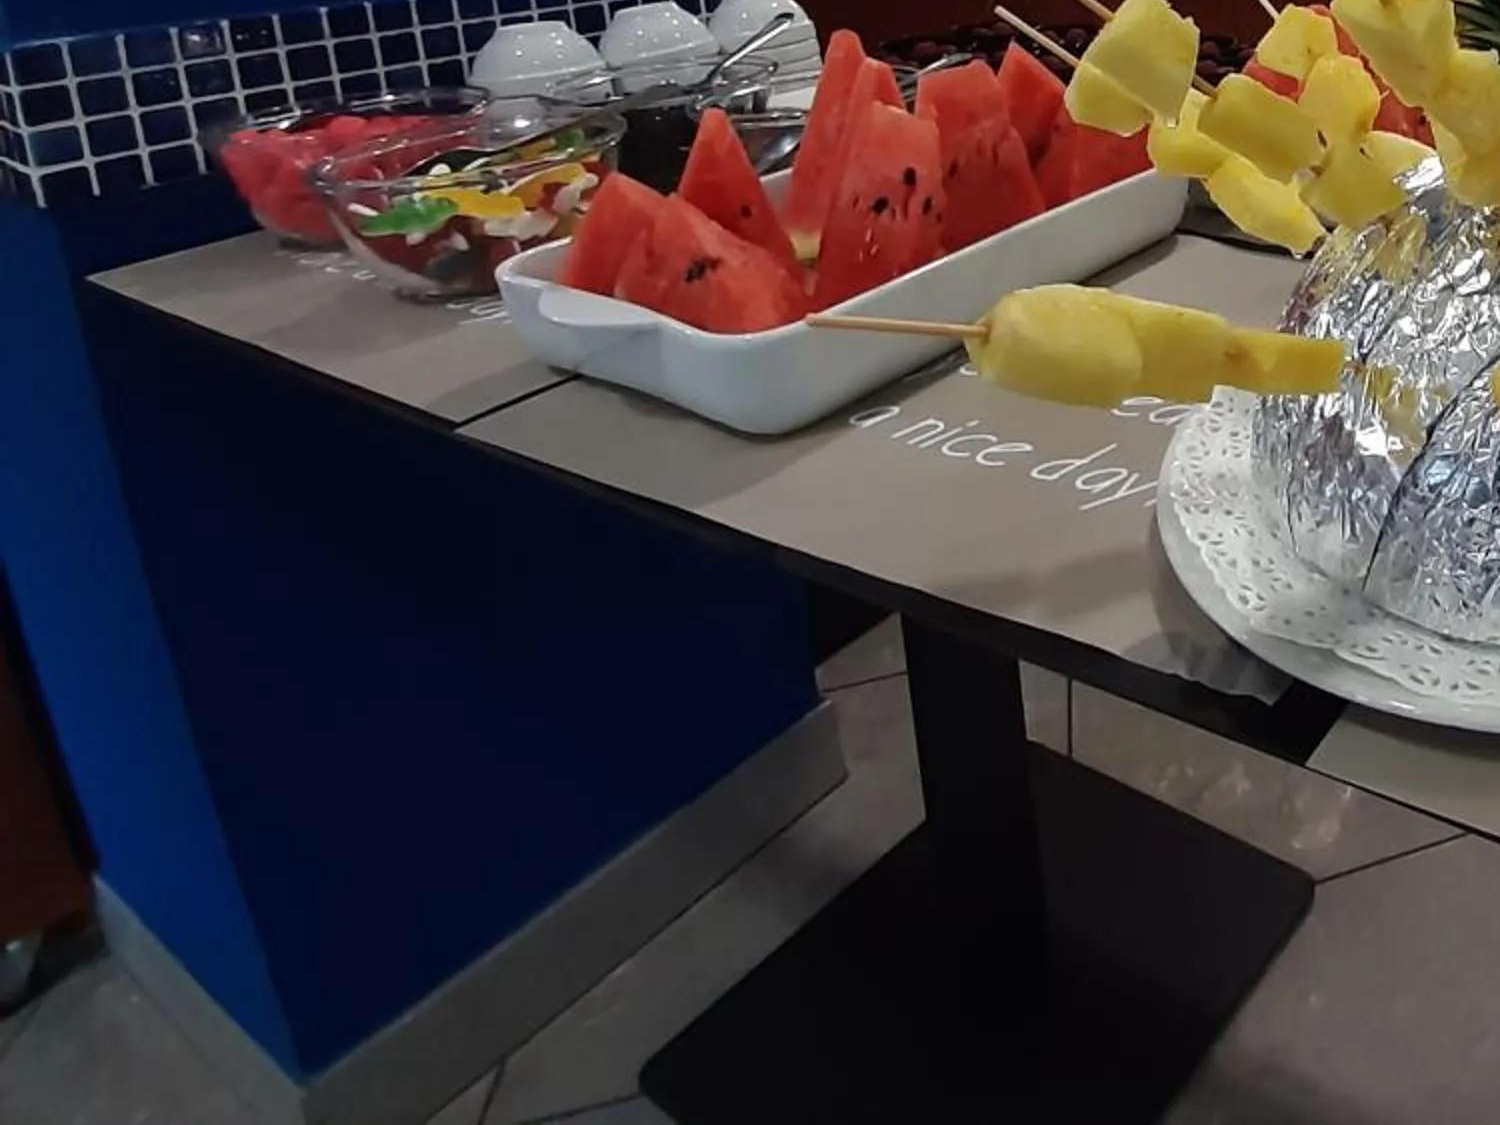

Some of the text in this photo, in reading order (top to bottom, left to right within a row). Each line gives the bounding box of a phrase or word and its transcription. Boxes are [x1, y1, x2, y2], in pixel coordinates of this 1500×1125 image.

[849, 405, 1158, 510] a nice day
